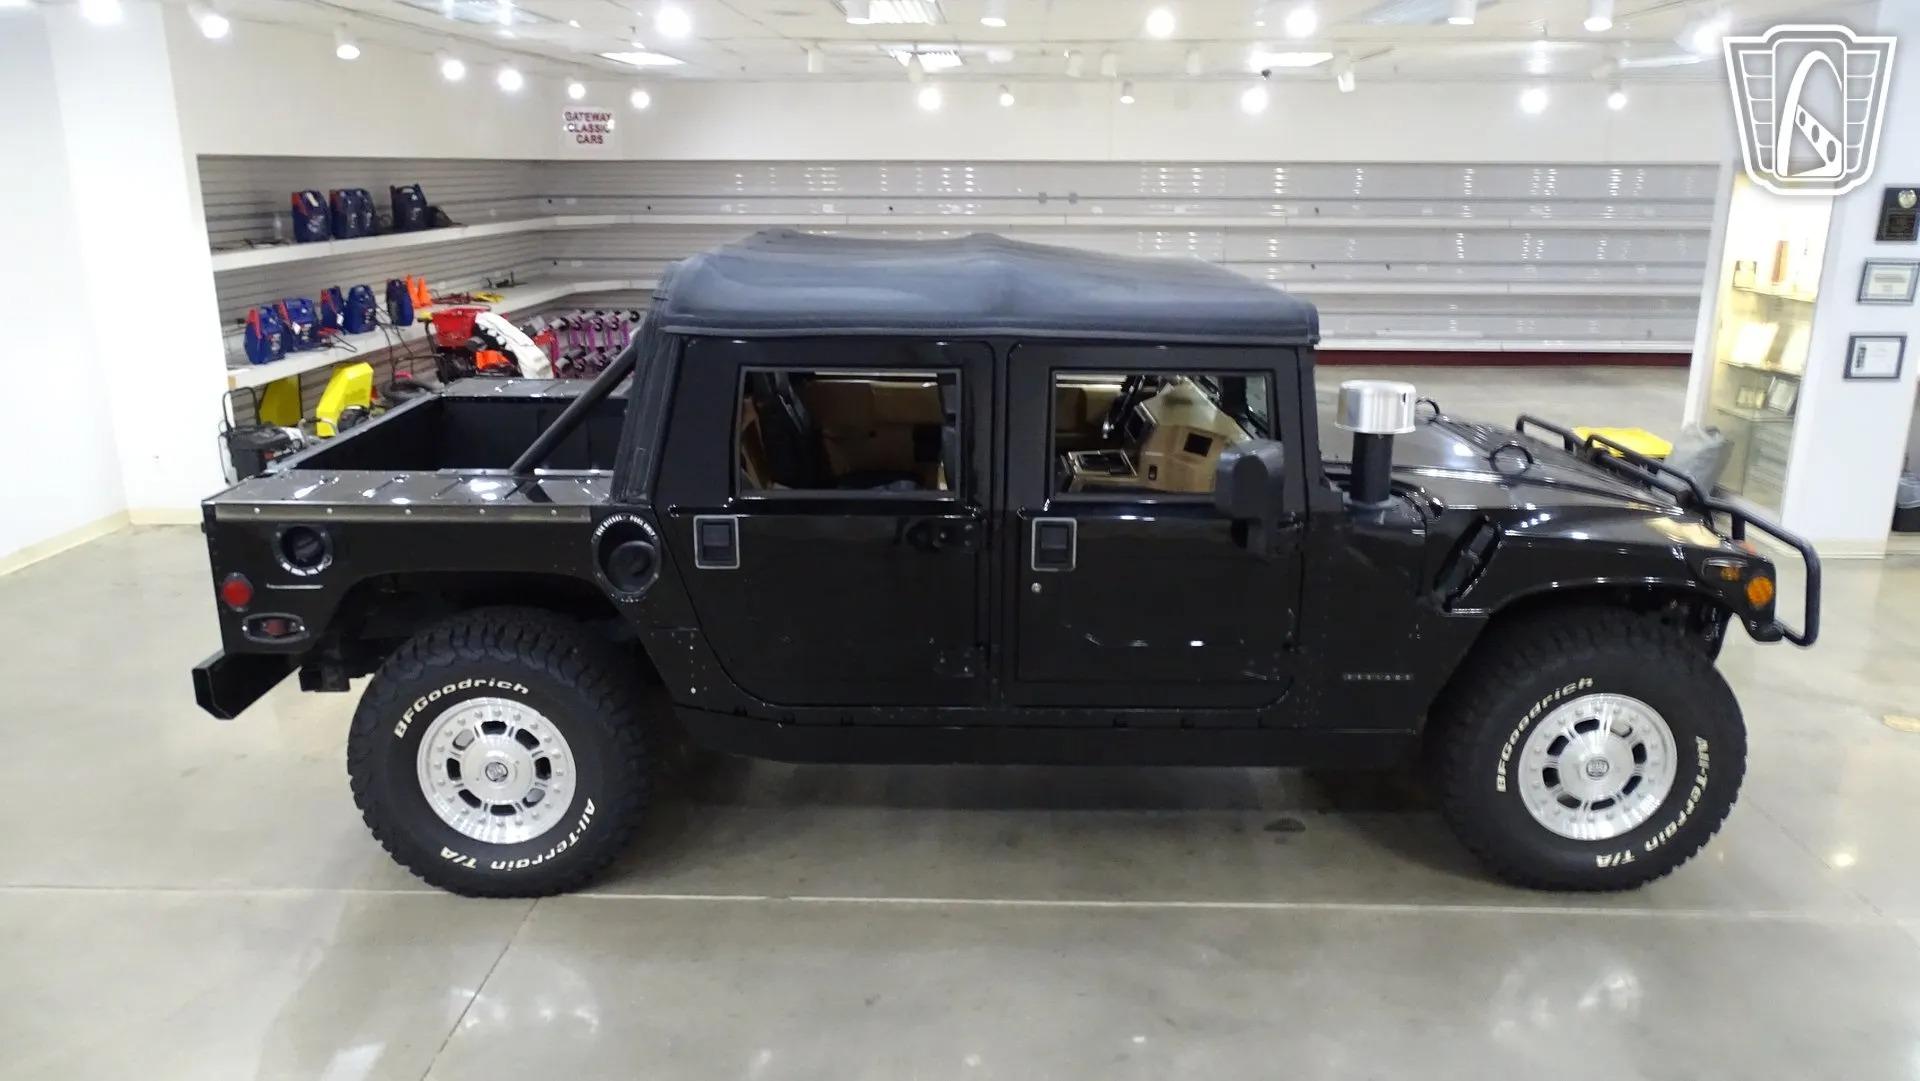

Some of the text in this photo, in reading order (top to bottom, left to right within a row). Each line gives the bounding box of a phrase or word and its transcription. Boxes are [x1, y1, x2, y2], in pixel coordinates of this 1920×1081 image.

[564, 111, 611, 122] GATEWAY
[567, 123, 611, 133] CLASSIC
[576, 134, 604, 144] CARS
[394, 678, 529, 739] BFGoodrich
[1496, 677, 1593, 792] BFGoodrich
[1595, 735, 1711, 868] All-Terrain T/A
[439, 798, 597, 872] All-Terrain T/A
